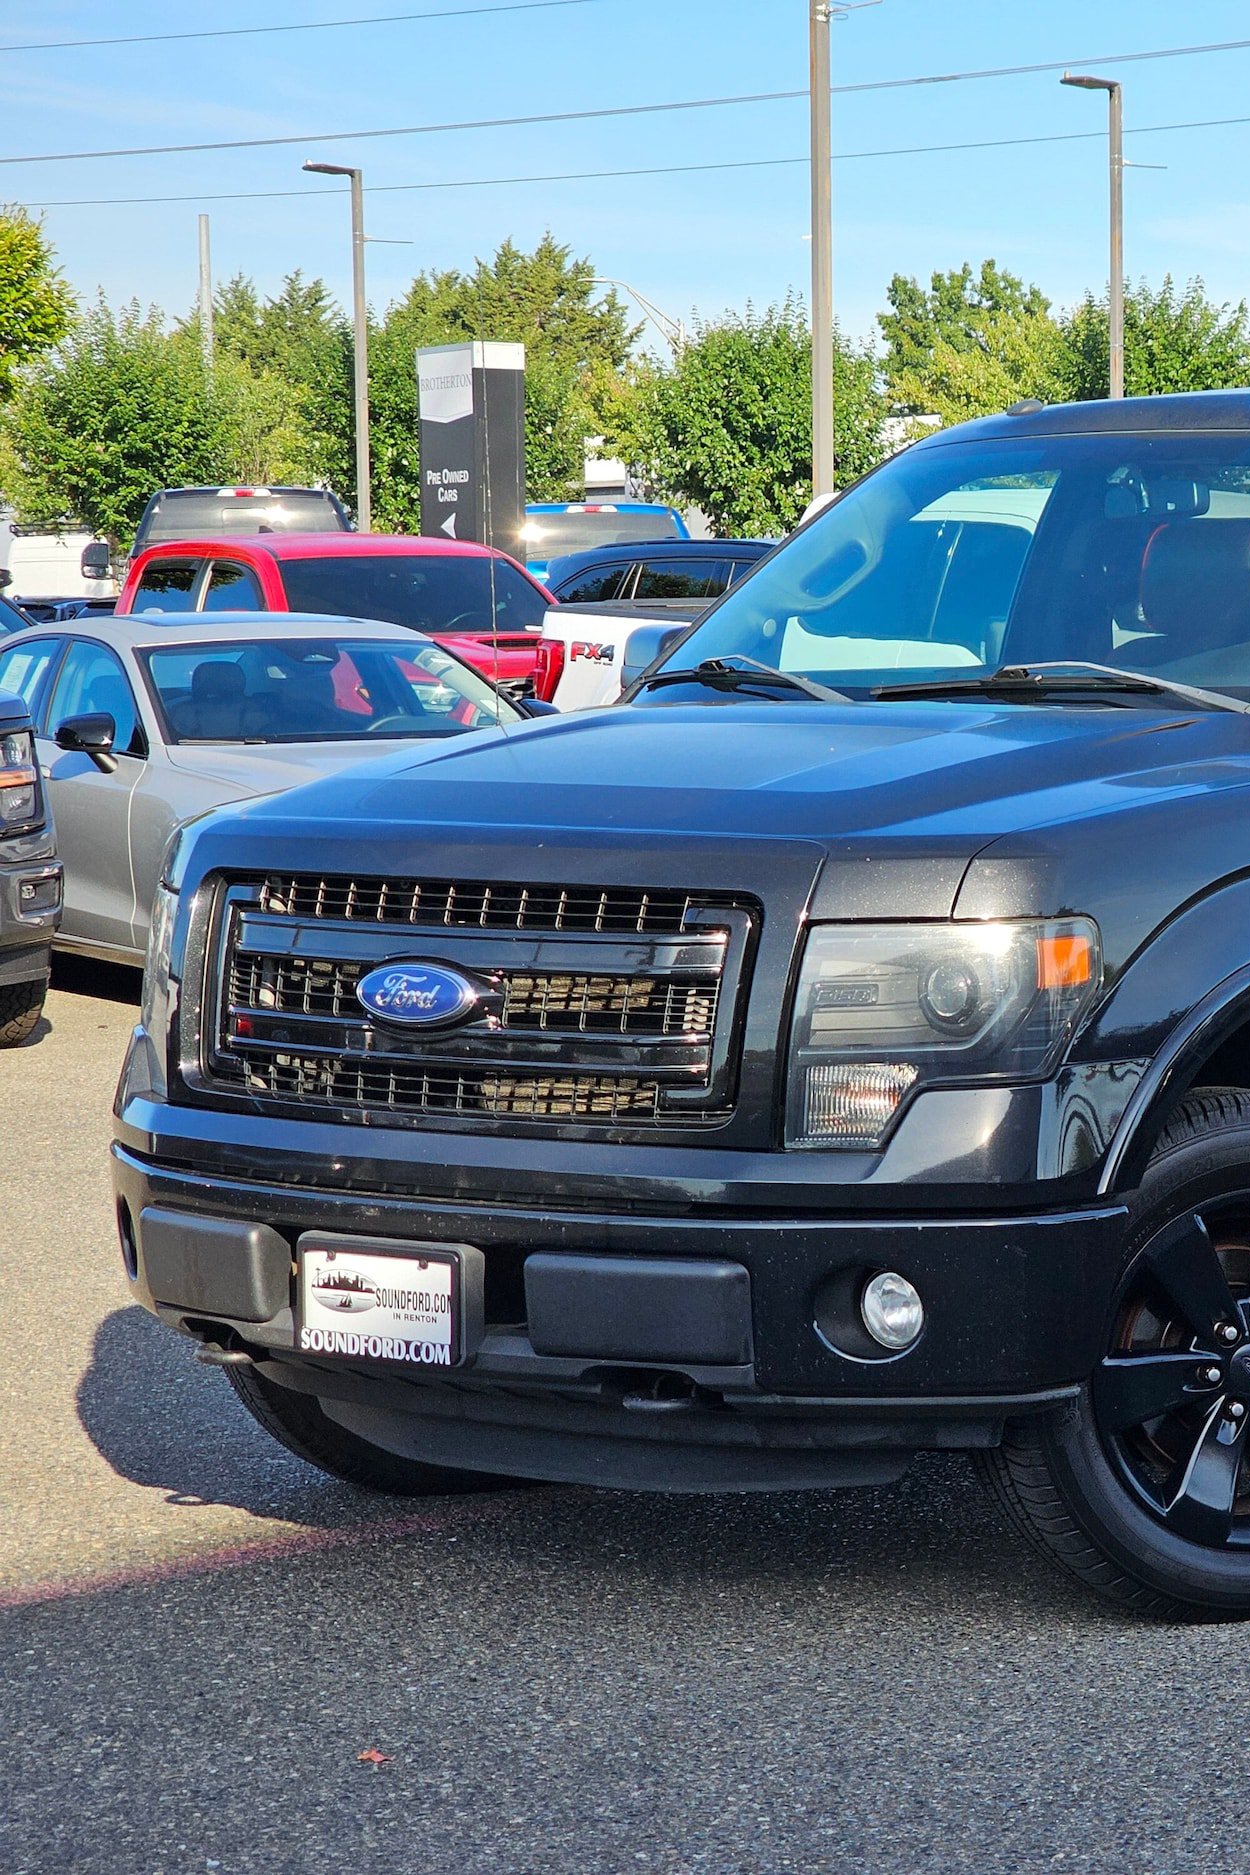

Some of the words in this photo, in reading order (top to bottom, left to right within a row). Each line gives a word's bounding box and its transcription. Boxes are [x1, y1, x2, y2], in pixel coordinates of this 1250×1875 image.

[421, 373, 472, 392] BROTHERTON
[426, 470, 442, 485] PRE
[442, 468, 469, 484] OWNED
[438, 487, 458, 502] CARS
[570, 641, 615, 662] FX4
[375, 973, 441, 1009] Ford
[393, 1312, 401, 1321] IN
[404, 1313, 437, 1324] RENTON
[301, 1327, 451, 1366] SOUNDFORD.COM
